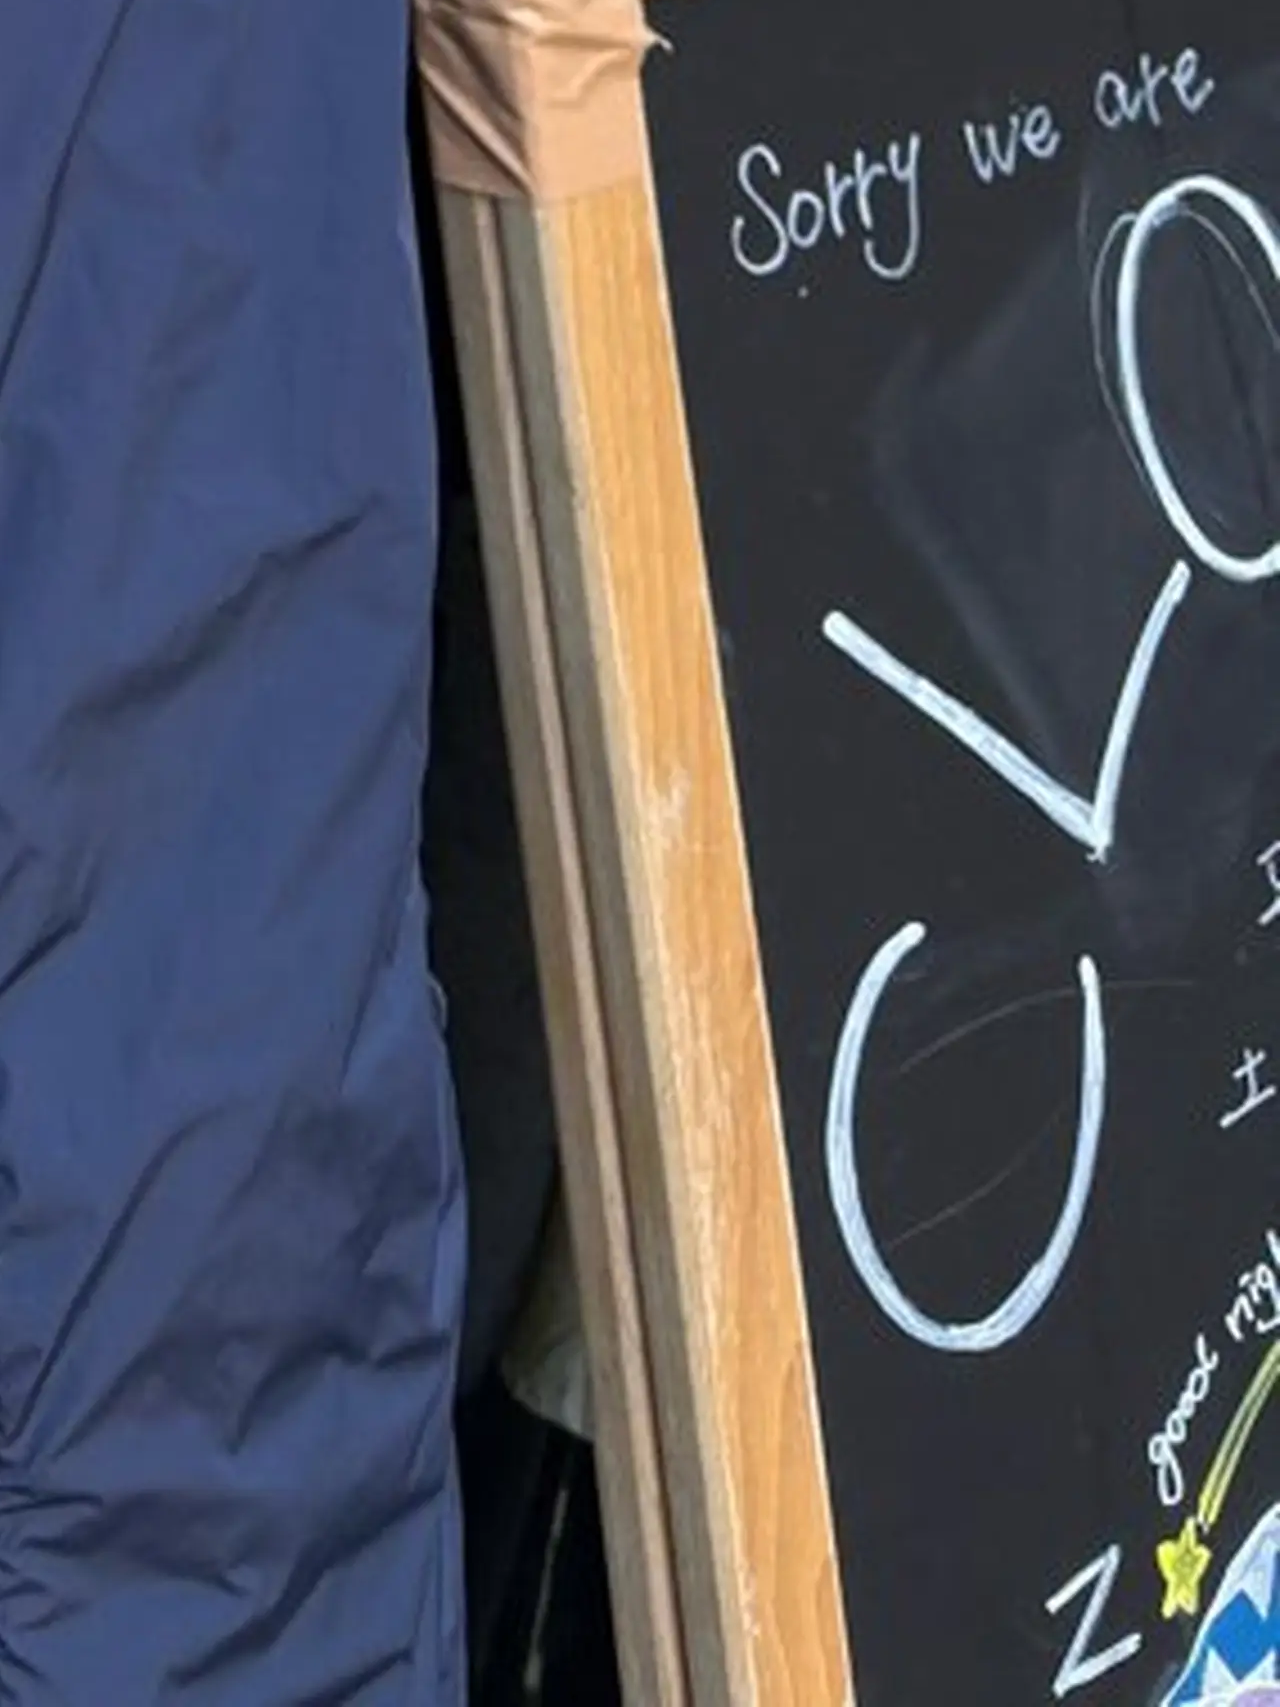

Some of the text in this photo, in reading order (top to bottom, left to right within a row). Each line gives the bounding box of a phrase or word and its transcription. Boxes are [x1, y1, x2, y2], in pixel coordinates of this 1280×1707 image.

[731, 46, 1215, 280] Sorry we are
